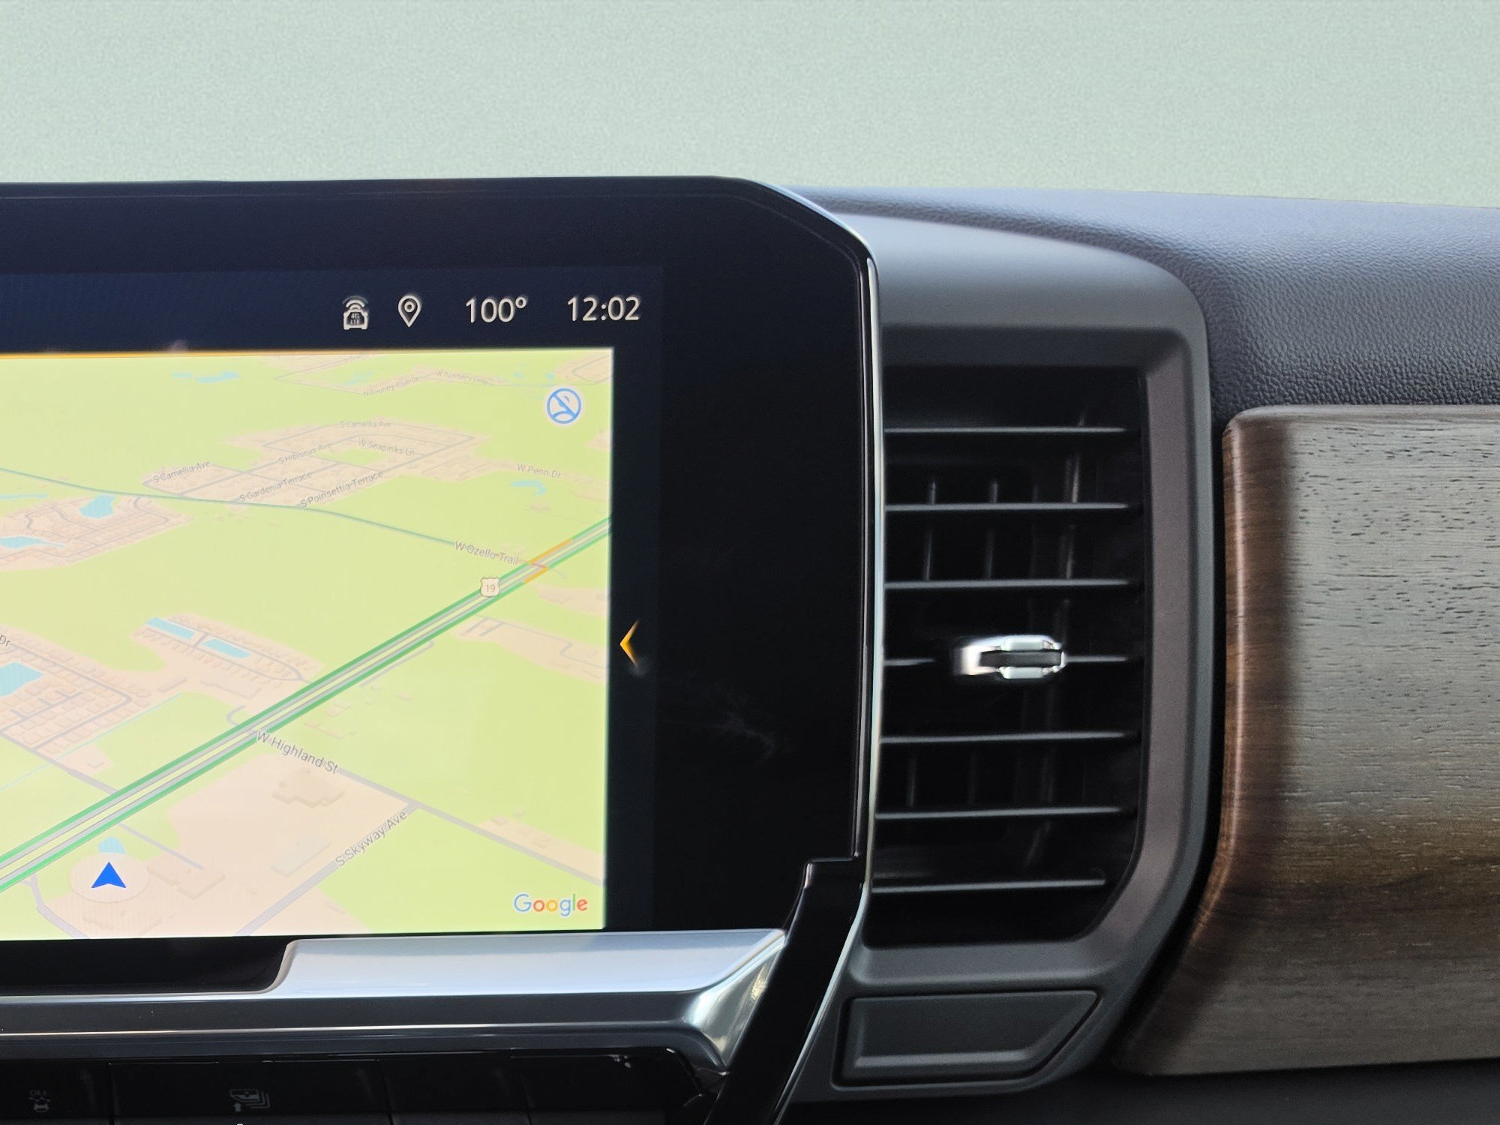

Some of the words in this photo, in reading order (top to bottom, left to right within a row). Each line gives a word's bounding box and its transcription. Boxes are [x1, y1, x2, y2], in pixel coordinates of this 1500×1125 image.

[567, 295, 642, 322] 12:02
[318, 442, 332, 454] Ave
[160, 464, 194, 482] Camellia
[195, 460, 211, 473] Ave
[516, 462, 526, 472] W
[527, 464, 548, 477] Penn
[550, 469, 562, 479] Dr
[238, 493, 246, 502] S
[246, 480, 281, 501] Gardenia
[281, 472, 312, 488] Terrace
[300, 498, 308, 509] S
[308, 480, 351, 505] Poinsettia
[351, 470, 384, 490] Terrace
[454, 540, 465, 552] W
[466, 543, 499, 561] Ozello
[499, 552, 520, 566] Trail
[485, 583, 496, 594] 19
[257, 729, 270, 744] W
[270, 736, 325, 769] Highland
[325, 760, 339, 775] St
[335, 855, 346, 867] S
[345, 827, 386, 861] Skyway
[386, 809, 408, 831] Ave
[513, 891, 589, 918] Google
